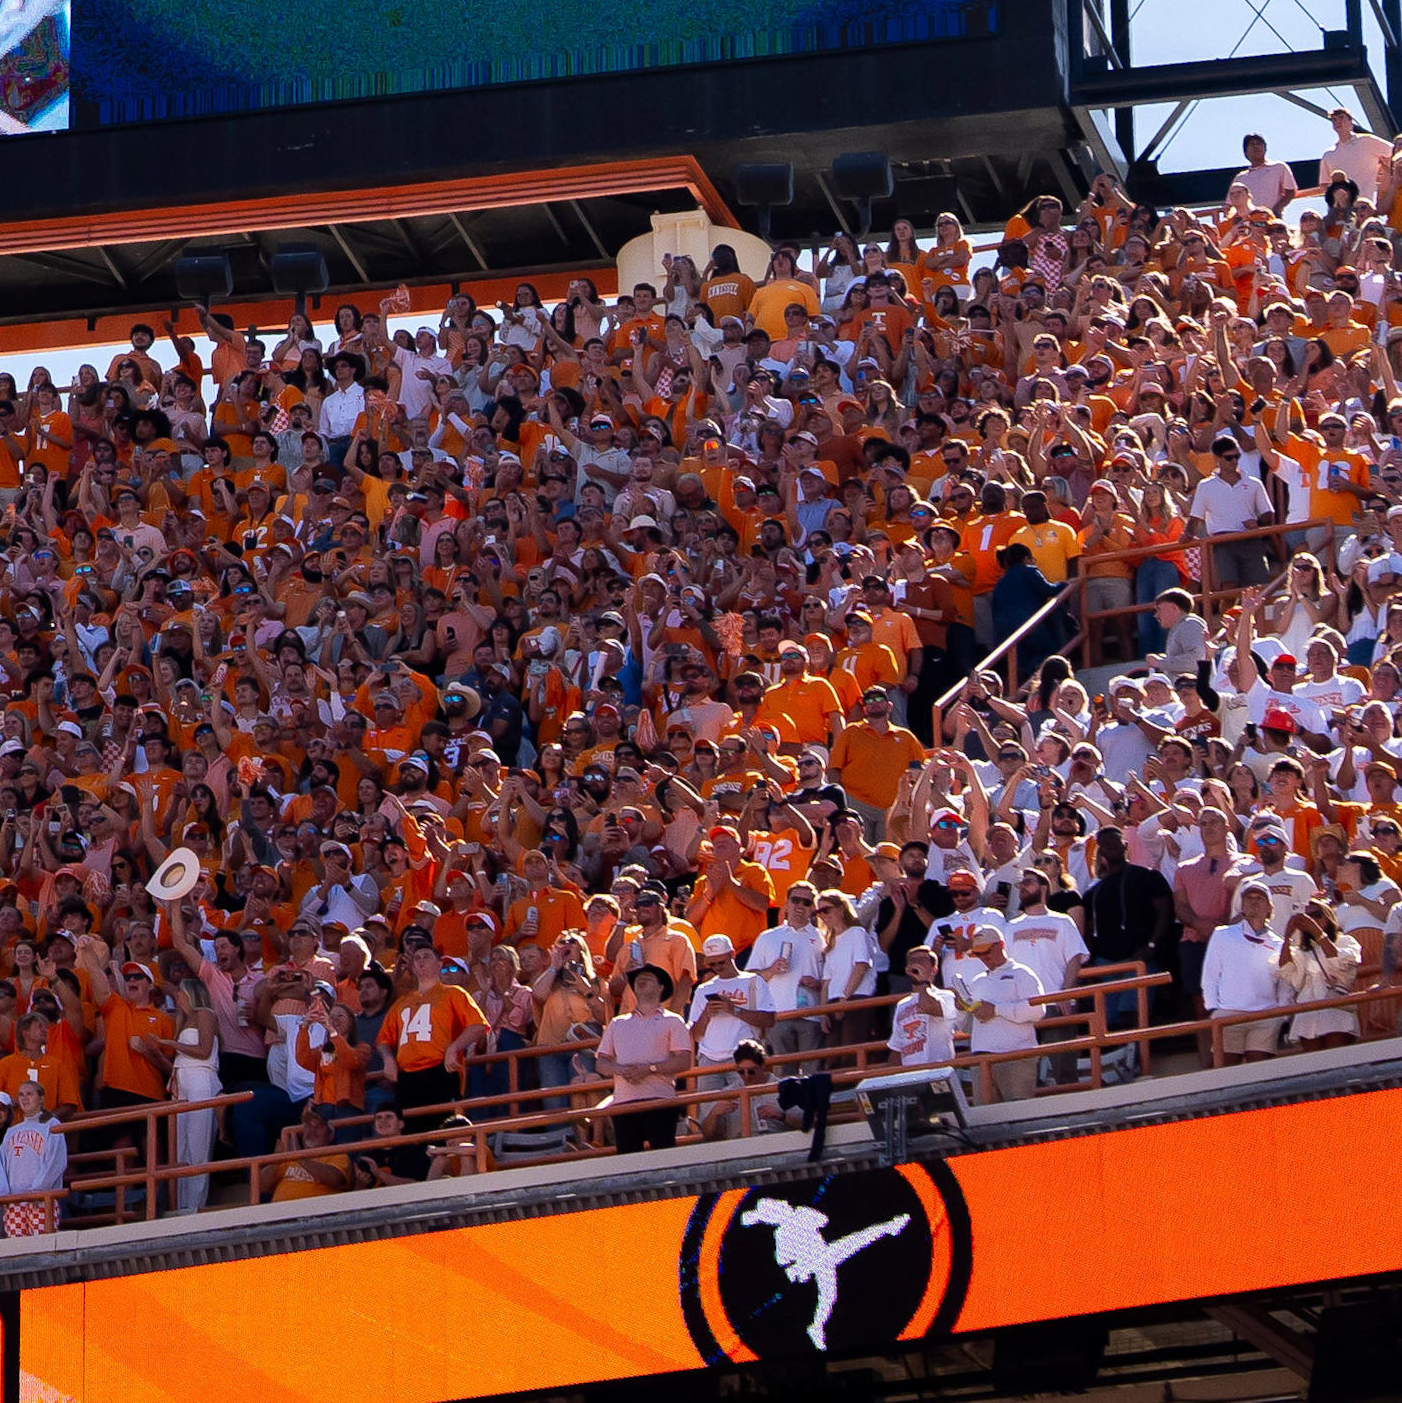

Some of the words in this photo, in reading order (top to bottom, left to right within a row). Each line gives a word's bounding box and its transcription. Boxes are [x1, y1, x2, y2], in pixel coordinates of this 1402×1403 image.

[871, 312, 886, 324] T
[979, 524, 993, 552] 1
[753, 838, 793, 870] 92
[399, 1004, 432, 1044] 14
[12, 1146, 23, 1157] T
